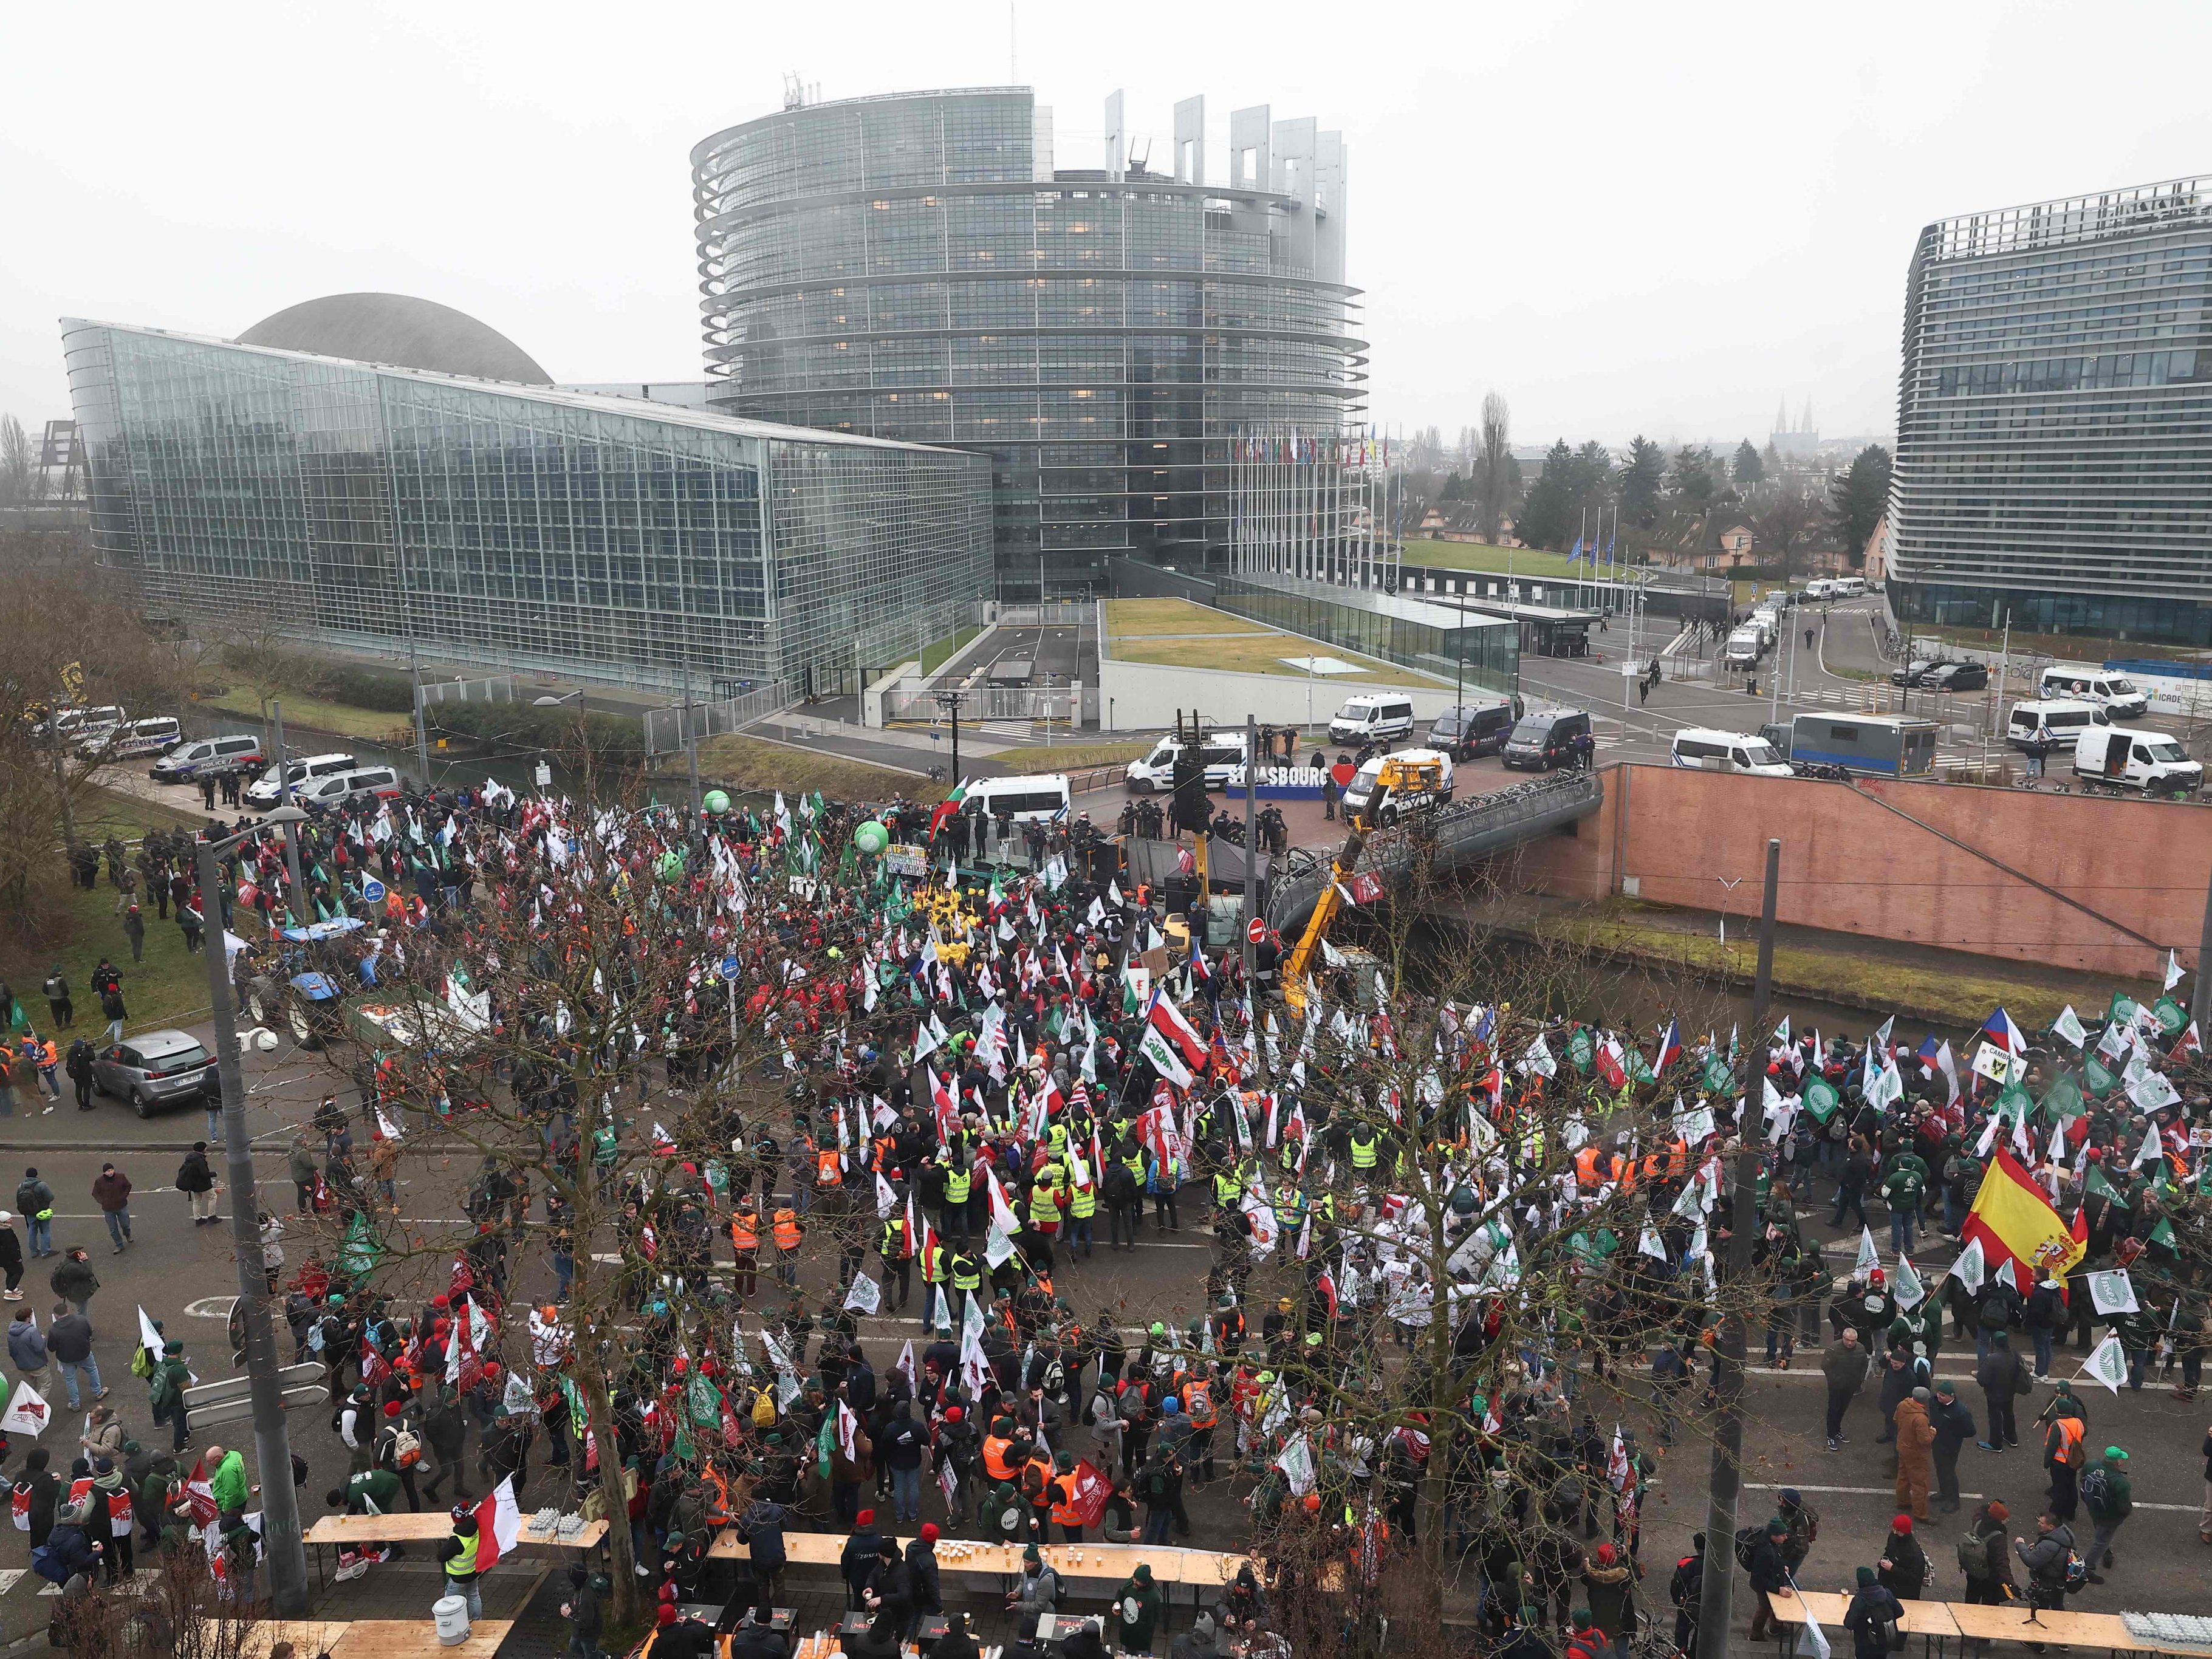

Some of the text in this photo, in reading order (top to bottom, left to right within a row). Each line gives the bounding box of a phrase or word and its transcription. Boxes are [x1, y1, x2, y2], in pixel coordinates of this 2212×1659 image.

[2159, 694, 2181, 703] ICADE
[201, 759, 227, 768] POLICE
[1227, 766, 1329, 787] STASBOURG
[2094, 1188, 2125, 1205] ASAJA
